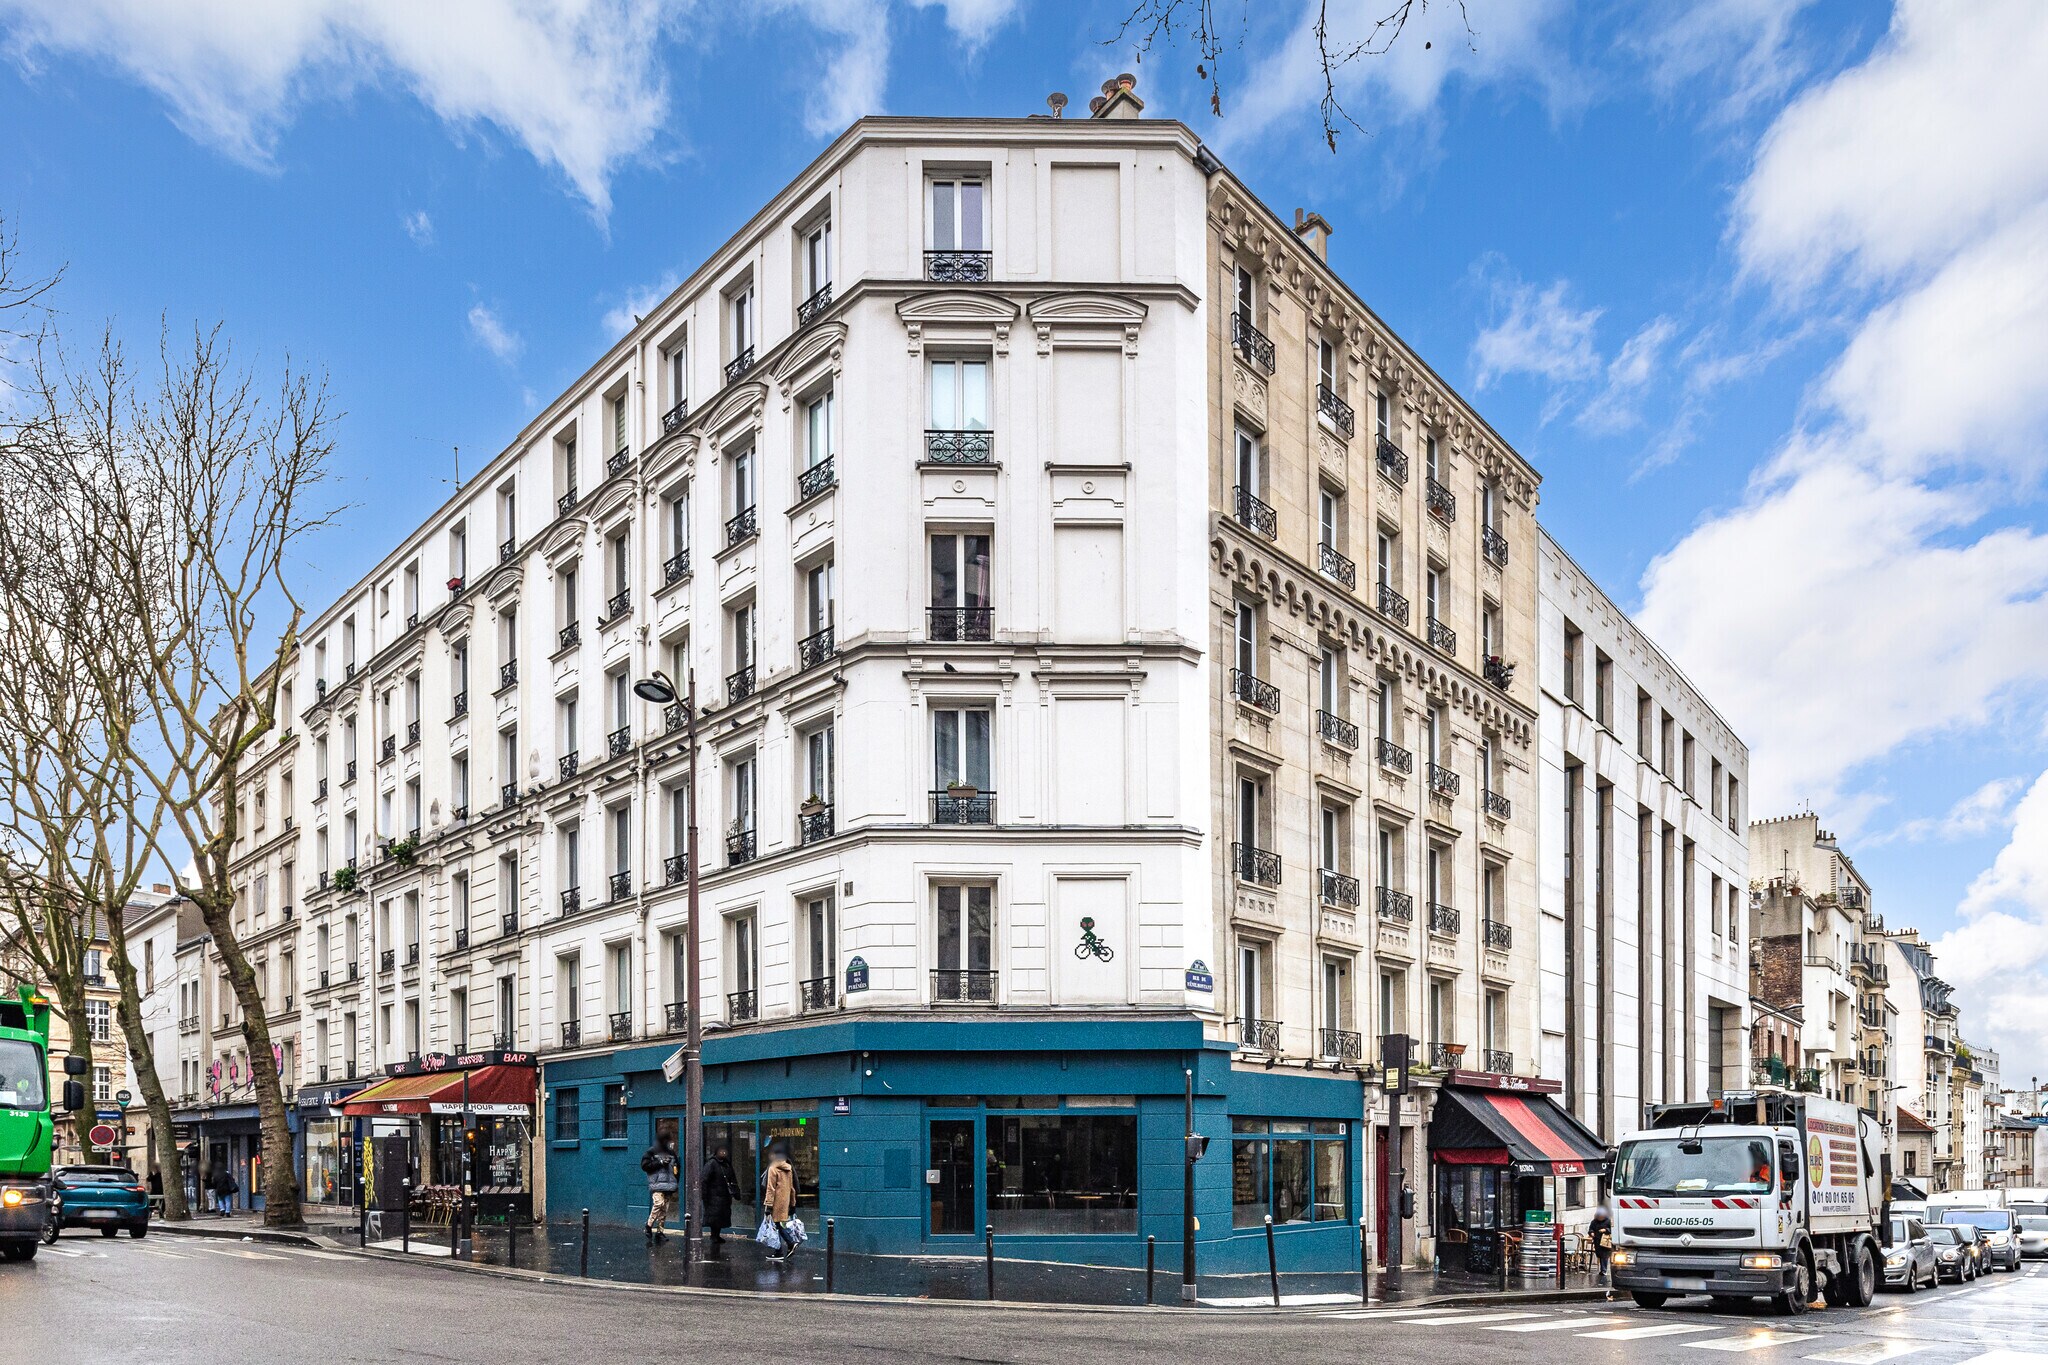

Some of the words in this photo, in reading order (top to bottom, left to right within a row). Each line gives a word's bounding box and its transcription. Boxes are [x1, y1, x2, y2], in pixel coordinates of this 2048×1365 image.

[503, 1053, 527, 1063] BAR
[1808, 1120, 1824, 1131] LOCATION
[770, 1127, 805, 1137] CO-WORKING
[1817, 1191, 1823, 1203] 01
[1825, 1191, 1832, 1204] 60
[1833, 1192, 1839, 1203] 01
[1841, 1192, 1847, 1203] 65
[1848, 1192, 1854, 1203] 05
[1653, 1217, 1714, 1226] 01-600-165-05
